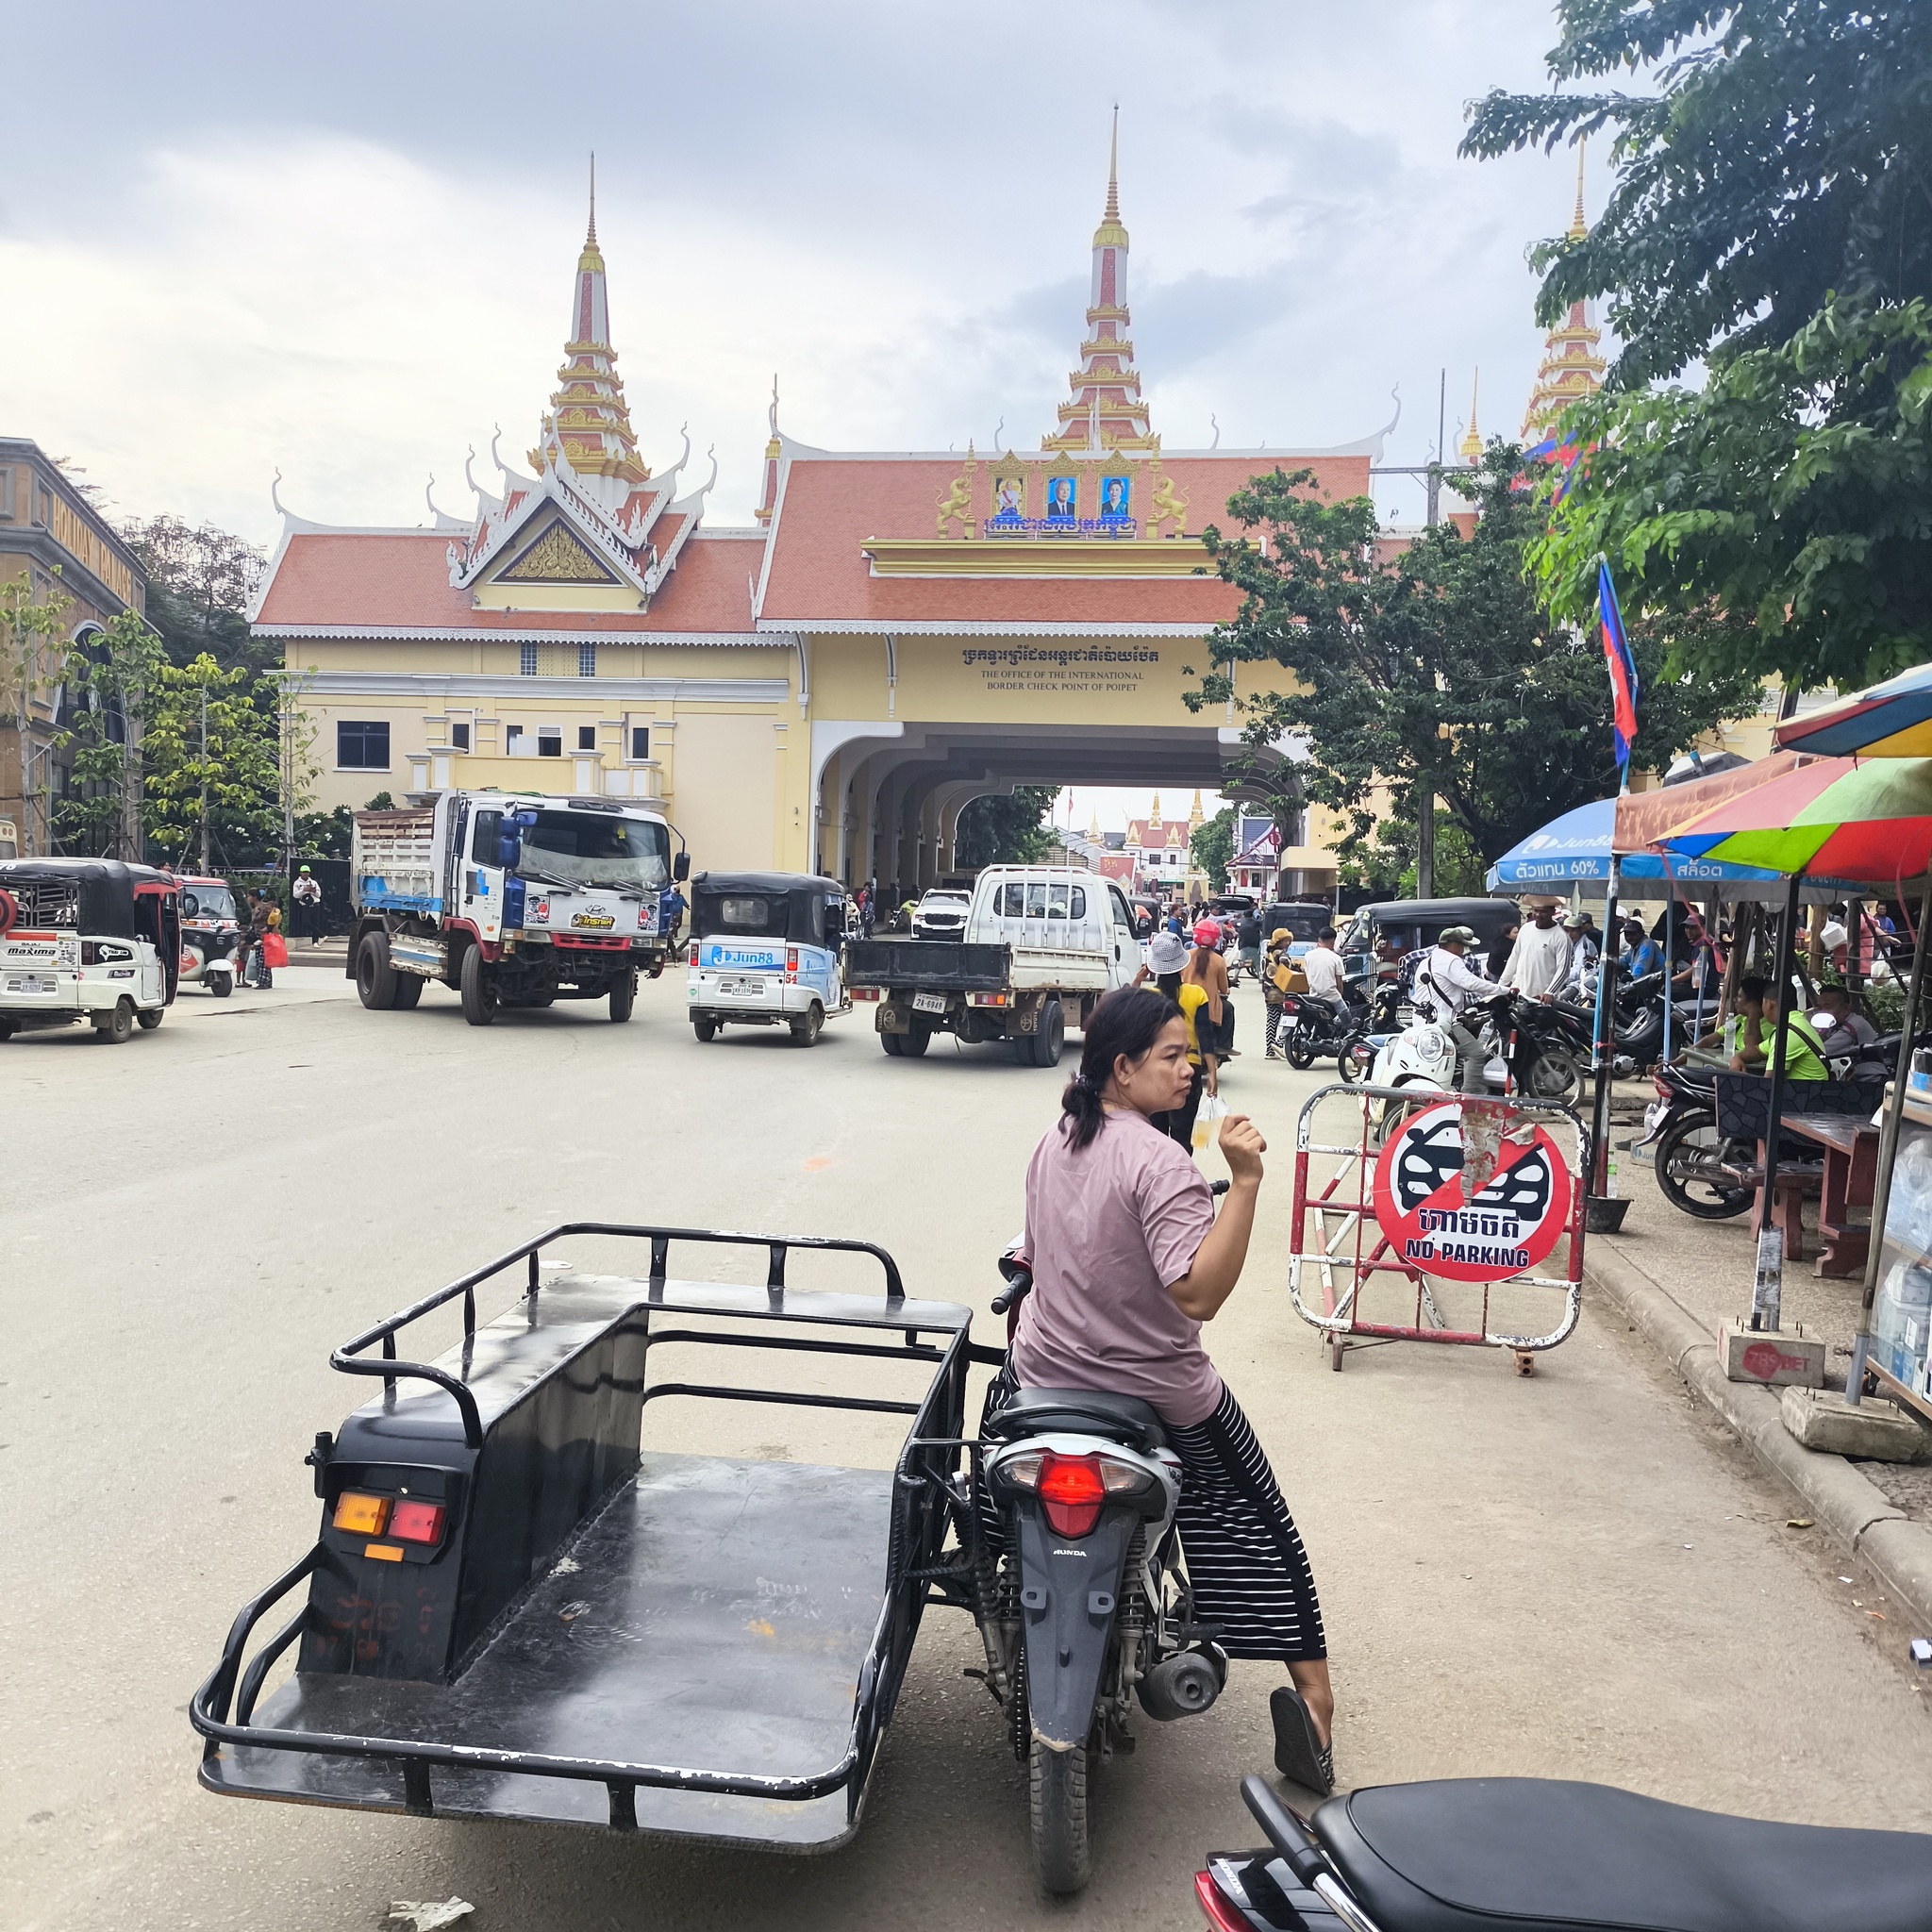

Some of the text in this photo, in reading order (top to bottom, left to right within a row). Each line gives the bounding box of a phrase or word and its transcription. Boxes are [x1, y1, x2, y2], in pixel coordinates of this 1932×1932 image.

[53, 492, 93, 567] HOLIDAY
[1001, 671, 1032, 679] OFFICE
[1034, 671, 1045, 679] OF
[1069, 672, 1144, 680] INTERNATIONAL
[1027, 682, 1058, 691] CHECK
[1516, 860, 1600, 878] ตัวแทน 60%
[733, 951, 774, 964] Jun88
[785, 974, 798, 985] 54
[1406, 1239, 1529, 1268] NO PARKING
[1053, 1549, 1088, 1557] HONDA
[1214, 1857, 1244, 1895] HONDA
